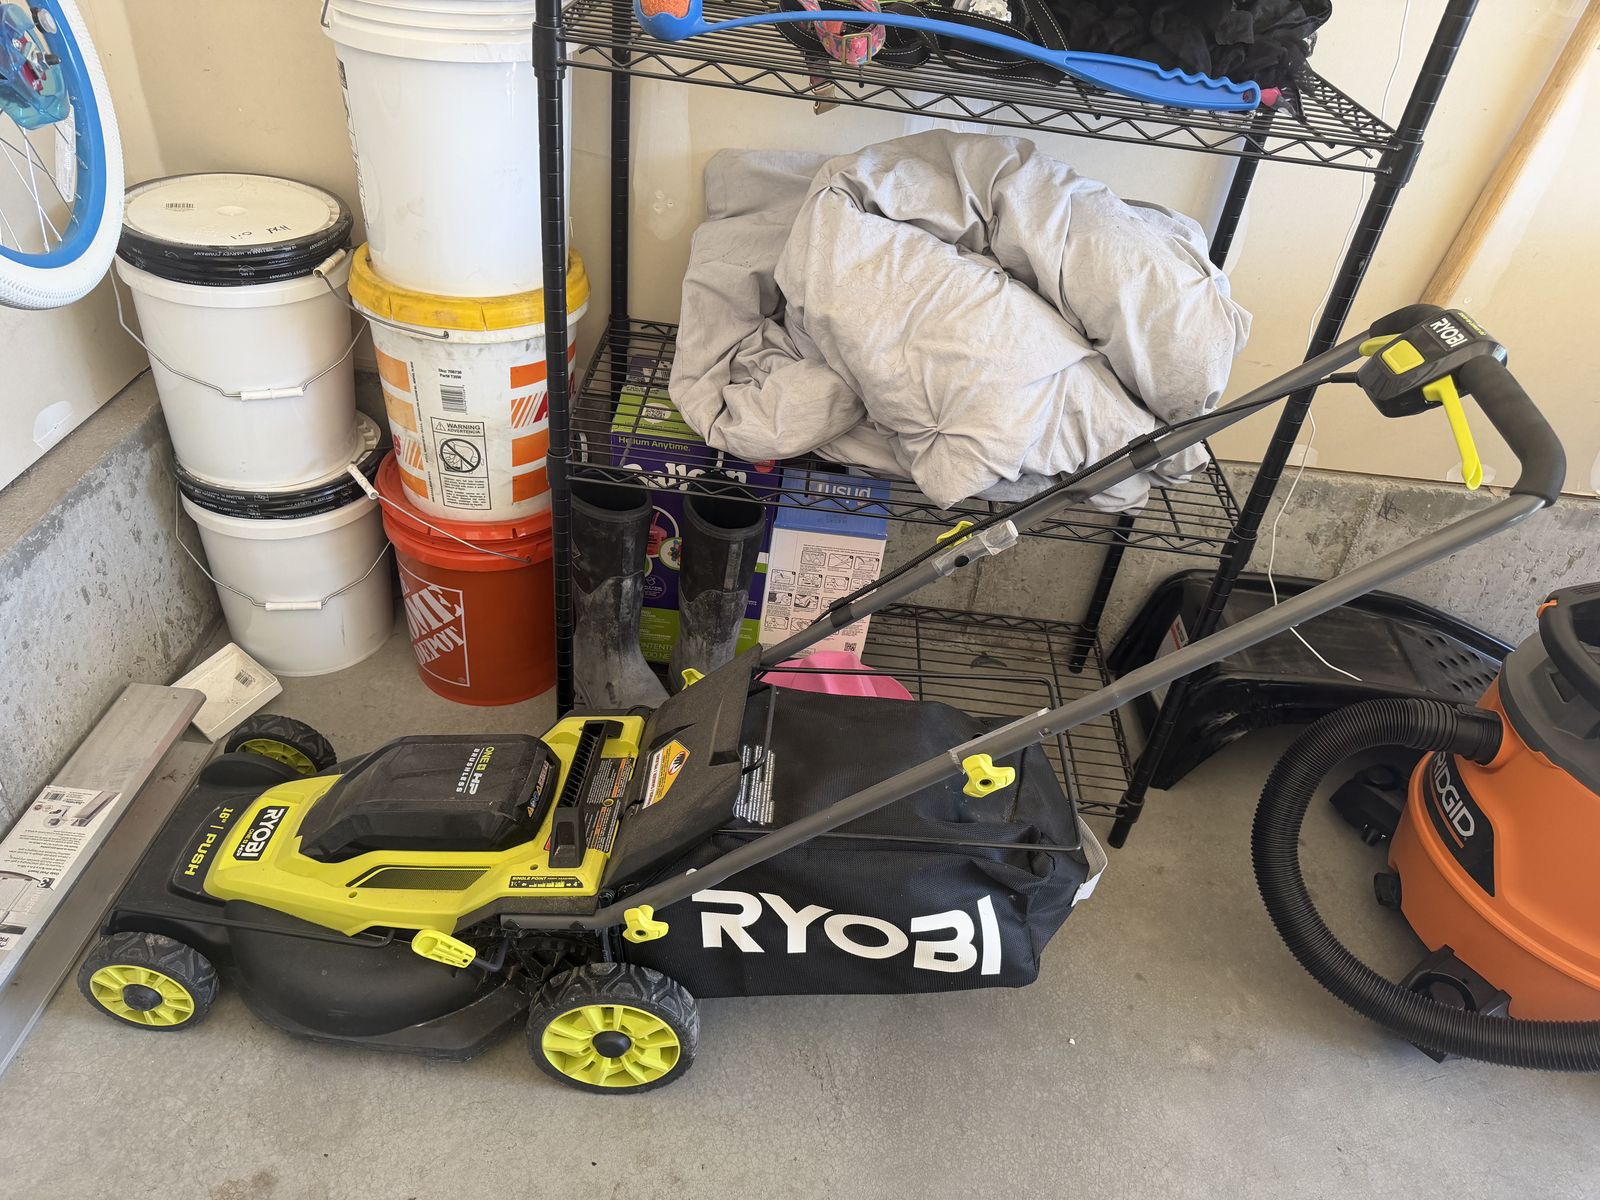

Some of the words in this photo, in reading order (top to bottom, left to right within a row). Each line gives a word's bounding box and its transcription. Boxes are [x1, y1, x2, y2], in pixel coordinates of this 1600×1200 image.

[1430, 317, 1468, 348] RYOBI
[446, 422, 481, 431] WARNING
[618, 436, 650, 446] Hium
[455, 748, 480, 793] BRUSHLESS
[469, 772, 483, 795] HP
[1433, 752, 1475, 837] RIDGID
[242, 808, 285, 857] RYOBI
[184, 833, 217, 876] PUSH
[692, 889, 1001, 975] RYOBI
